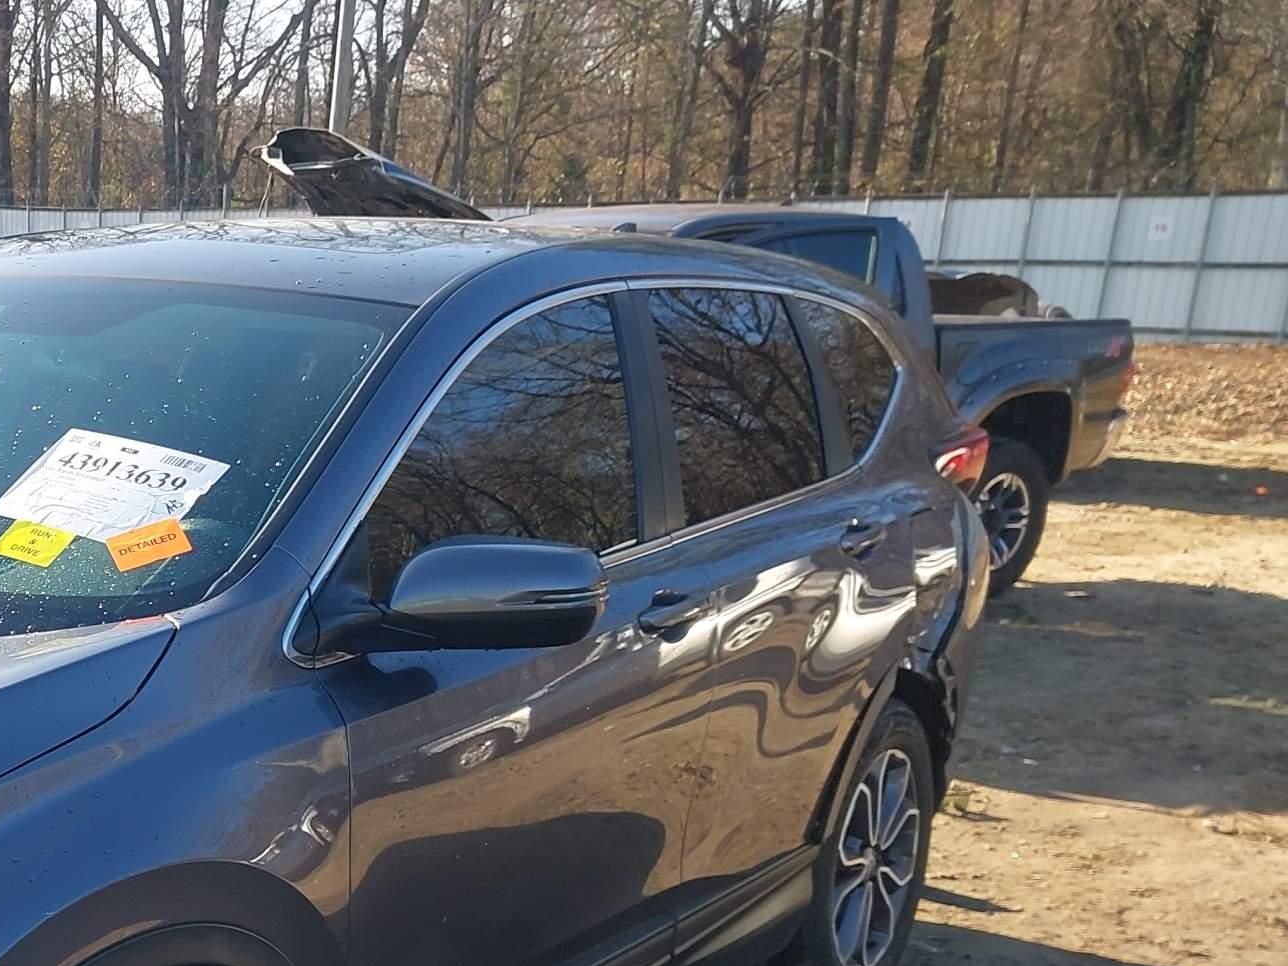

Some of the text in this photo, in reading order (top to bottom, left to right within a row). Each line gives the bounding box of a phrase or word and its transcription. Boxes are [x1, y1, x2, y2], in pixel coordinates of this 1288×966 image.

[58, 450, 188, 492] 43913639
[30, 528, 52, 539] RUN
[9, 544, 41, 557] DRIVE
[117, 532, 178, 557] DETAILED
